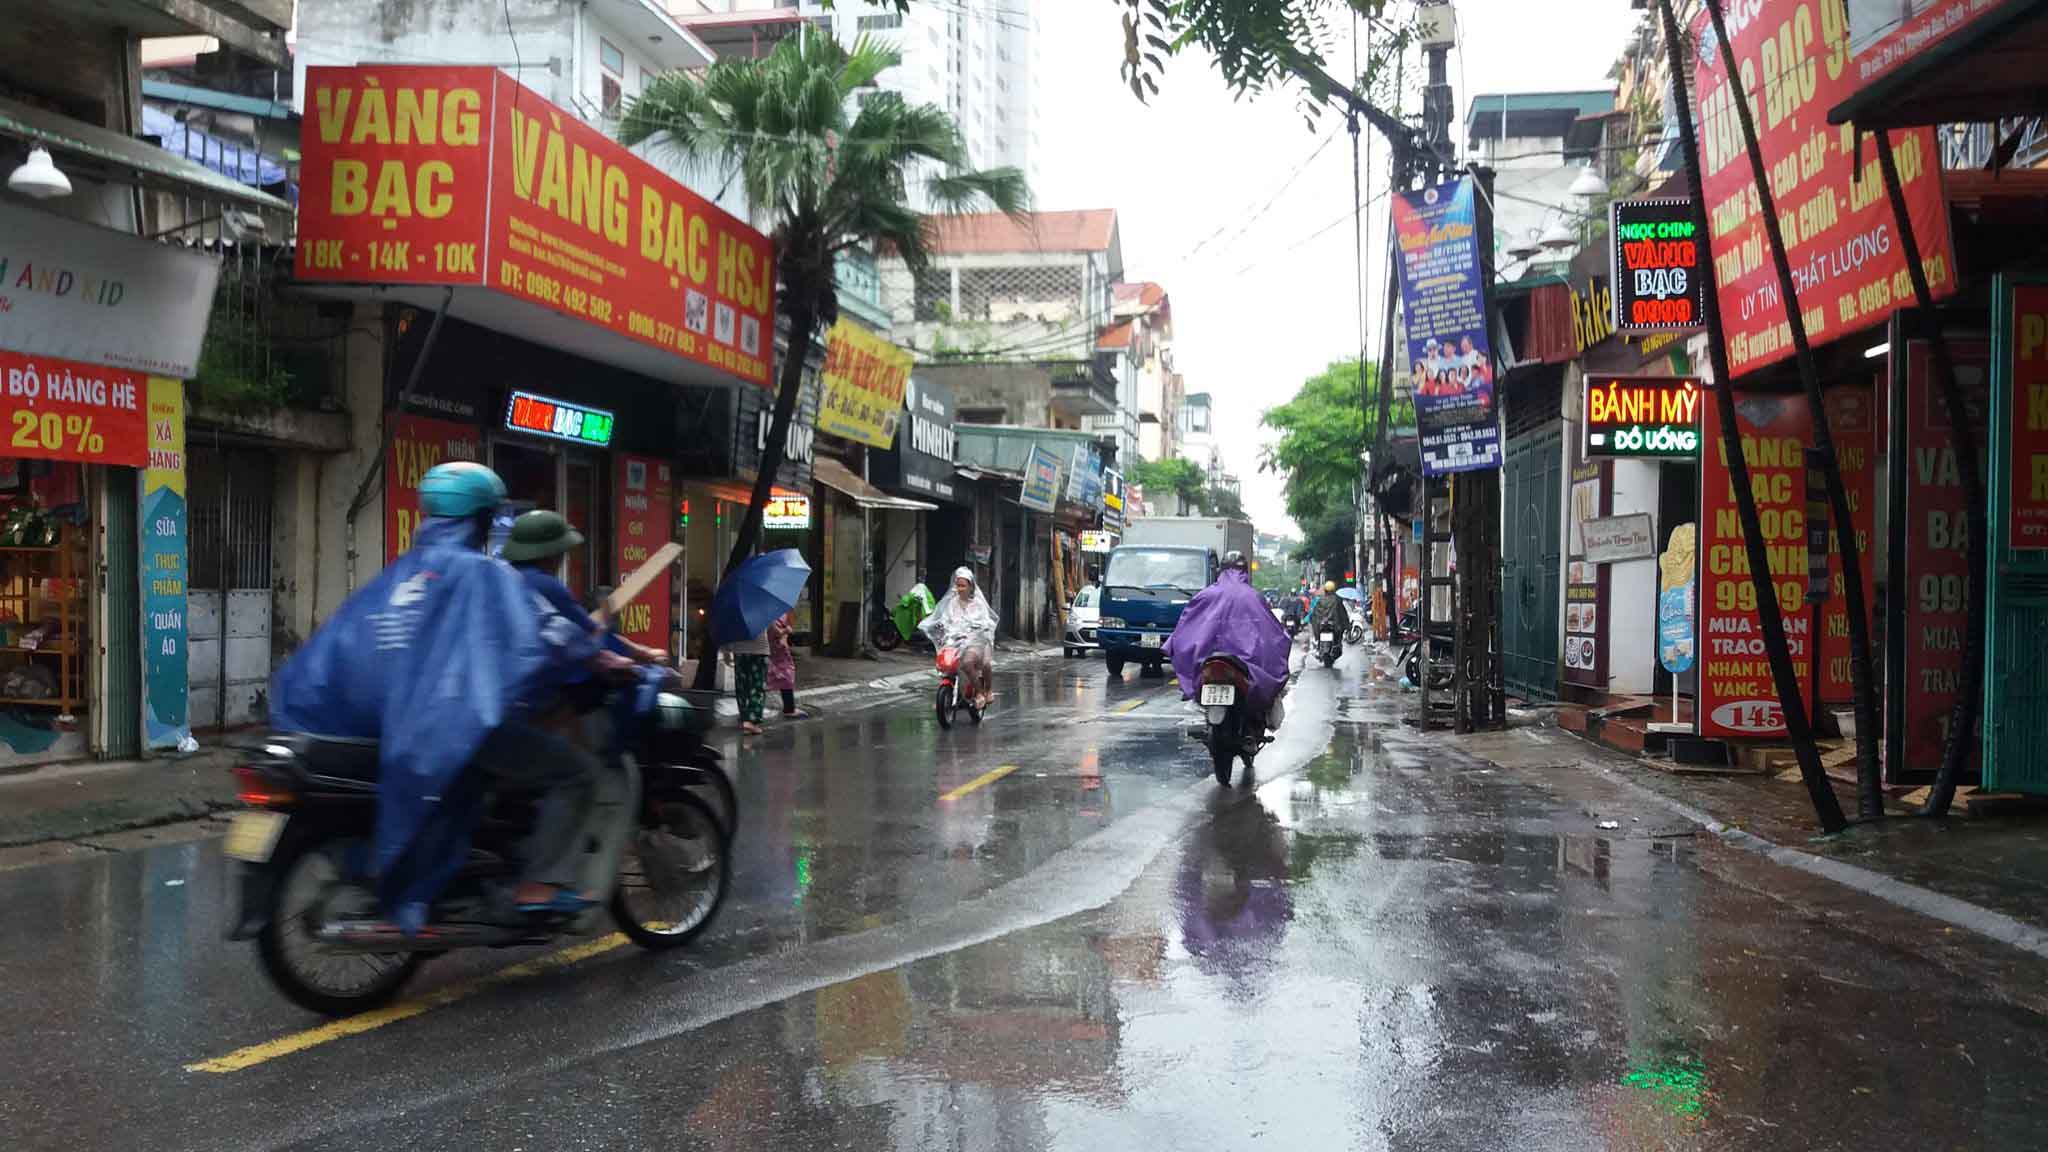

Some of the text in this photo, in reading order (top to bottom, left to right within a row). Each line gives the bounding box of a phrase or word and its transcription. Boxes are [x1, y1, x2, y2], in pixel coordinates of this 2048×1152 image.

[1760, 3, 1816, 132] BẠC
[316, 76, 481, 146] VÀNG
[1774, 151, 1798, 200] CAO
[331, 161, 454, 230] BẠC
[511, 106, 629, 247] VÀNG
[640, 183, 708, 288] BẠC
[717, 230, 771, 316] HSJ
[1621, 224, 1655, 241] NGỌC
[304, 240, 344, 269] 18K
[368, 241, 410, 272] 14K
[434, 242, 476, 273] 10K
[1740, 291, 1756, 320] UY
[1831, 224, 1890, 278] LƯỢNG
[16, 262, 73, 296] AND
[1635, 268, 1687, 300] BẠC
[9, 363, 40, 406] BỘ
[47, 369, 106, 406] HÀNG
[112, 379, 137, 409] HÈ
[1591, 381, 1654, 422] BÁNH
[11, 409, 104, 454] 20%
[1646, 425, 1697, 450] UỐNG
[1716, 508, 1804, 545] NỌC
[1709, 544, 1809, 576] CHNH
[1709, 617, 1752, 634] MUA
[1711, 639, 1766, 656] TRAO
